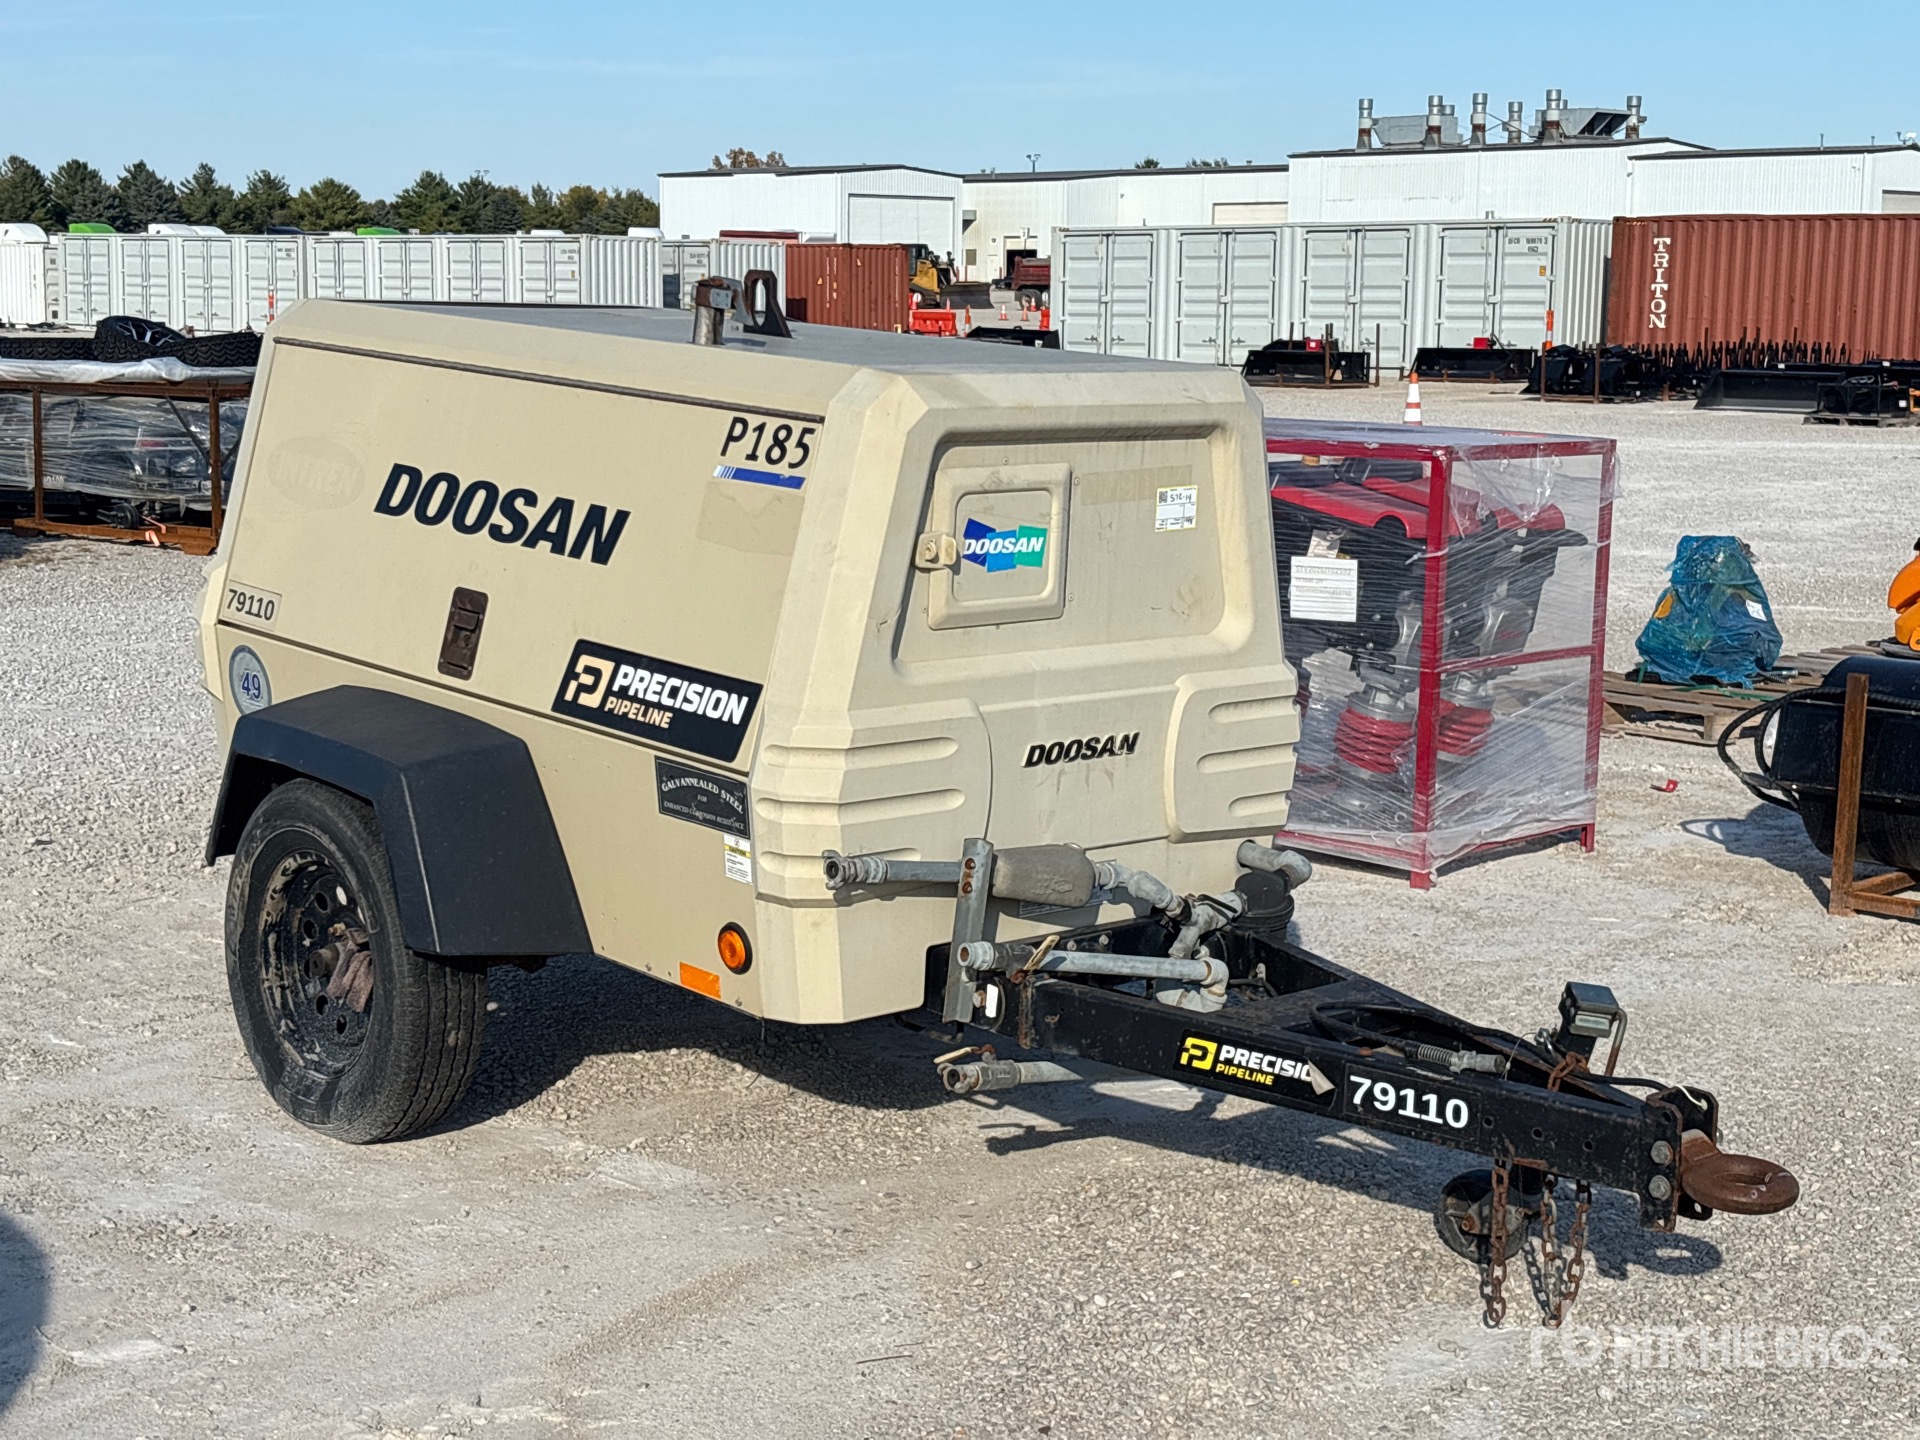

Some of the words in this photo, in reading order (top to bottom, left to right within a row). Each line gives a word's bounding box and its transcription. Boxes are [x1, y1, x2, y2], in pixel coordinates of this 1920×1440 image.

[1649, 237, 1671, 329] TRITON
[720, 416, 816, 469] P185
[373, 462, 632, 566] DOOSAN
[963, 536, 1045, 555] DOOSAN
[226, 588, 275, 621] 79110
[241, 671, 262, 700] 49
[612, 664, 749, 725] PRECISION
[603, 695, 674, 729] PIPELINE
[1021, 731, 1141, 768] DOOSAN
[661, 777, 719, 794] GALVANNEALED
[721, 789, 744, 815] STEEL
[697, 794, 708, 803] FOR
[1215, 1062, 1275, 1086] PIPELINE
[1218, 1044, 1312, 1082] PRECISIO
[1349, 1074, 1469, 1129] 79110
